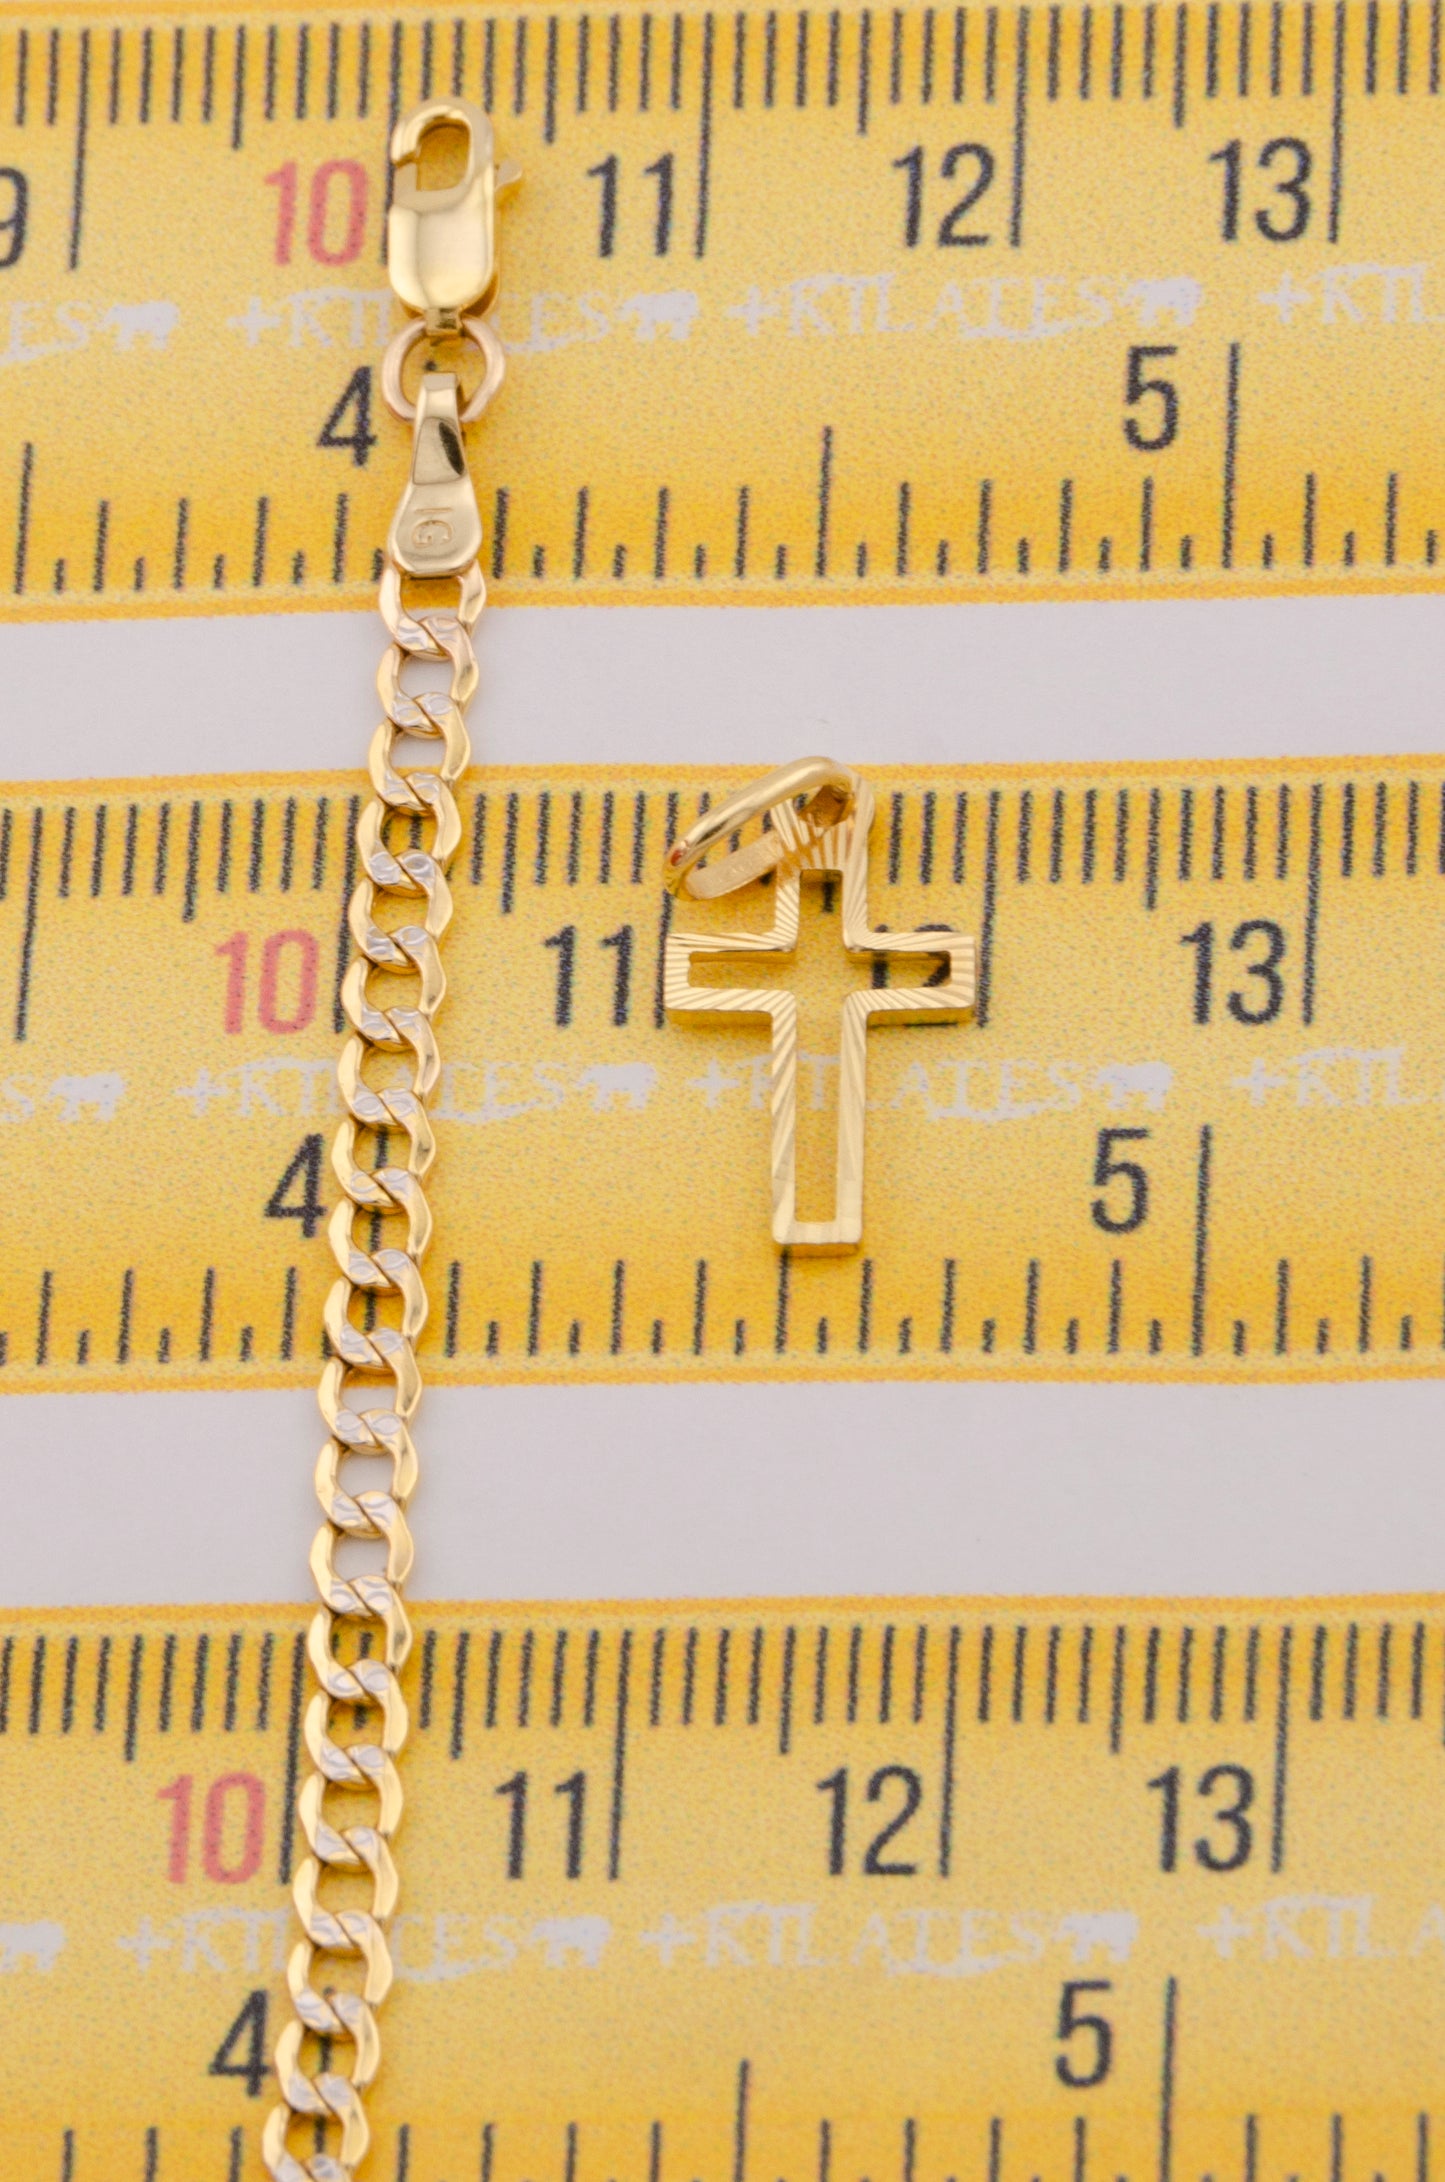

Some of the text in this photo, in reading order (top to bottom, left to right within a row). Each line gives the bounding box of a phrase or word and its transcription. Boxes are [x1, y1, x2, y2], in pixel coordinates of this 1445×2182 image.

[264, 160, 369, 267] 10
[587, 153, 674, 258] 11
[893, 143, 995, 248] 12
[1209, 137, 1313, 243] 13
[316, 365, 377, 467] 4
[1123, 345, 1179, 452] 5
[214, 929, 319, 1034] 10
[543, 924, 633, 1028] 11
[1179, 919, 1287, 1026] 13
[263, 1133, 327, 1239] 4
[1090, 1127, 1150, 1235] 5
[156, 1771, 266, 1884] 10
[495, 1770, 586, 1880] 11
[816, 1764, 923, 1877] 12
[1147, 1763, 1255, 1873] 13
[208, 1989, 270, 2098] 4
[1055, 1979, 1113, 2089] 5
